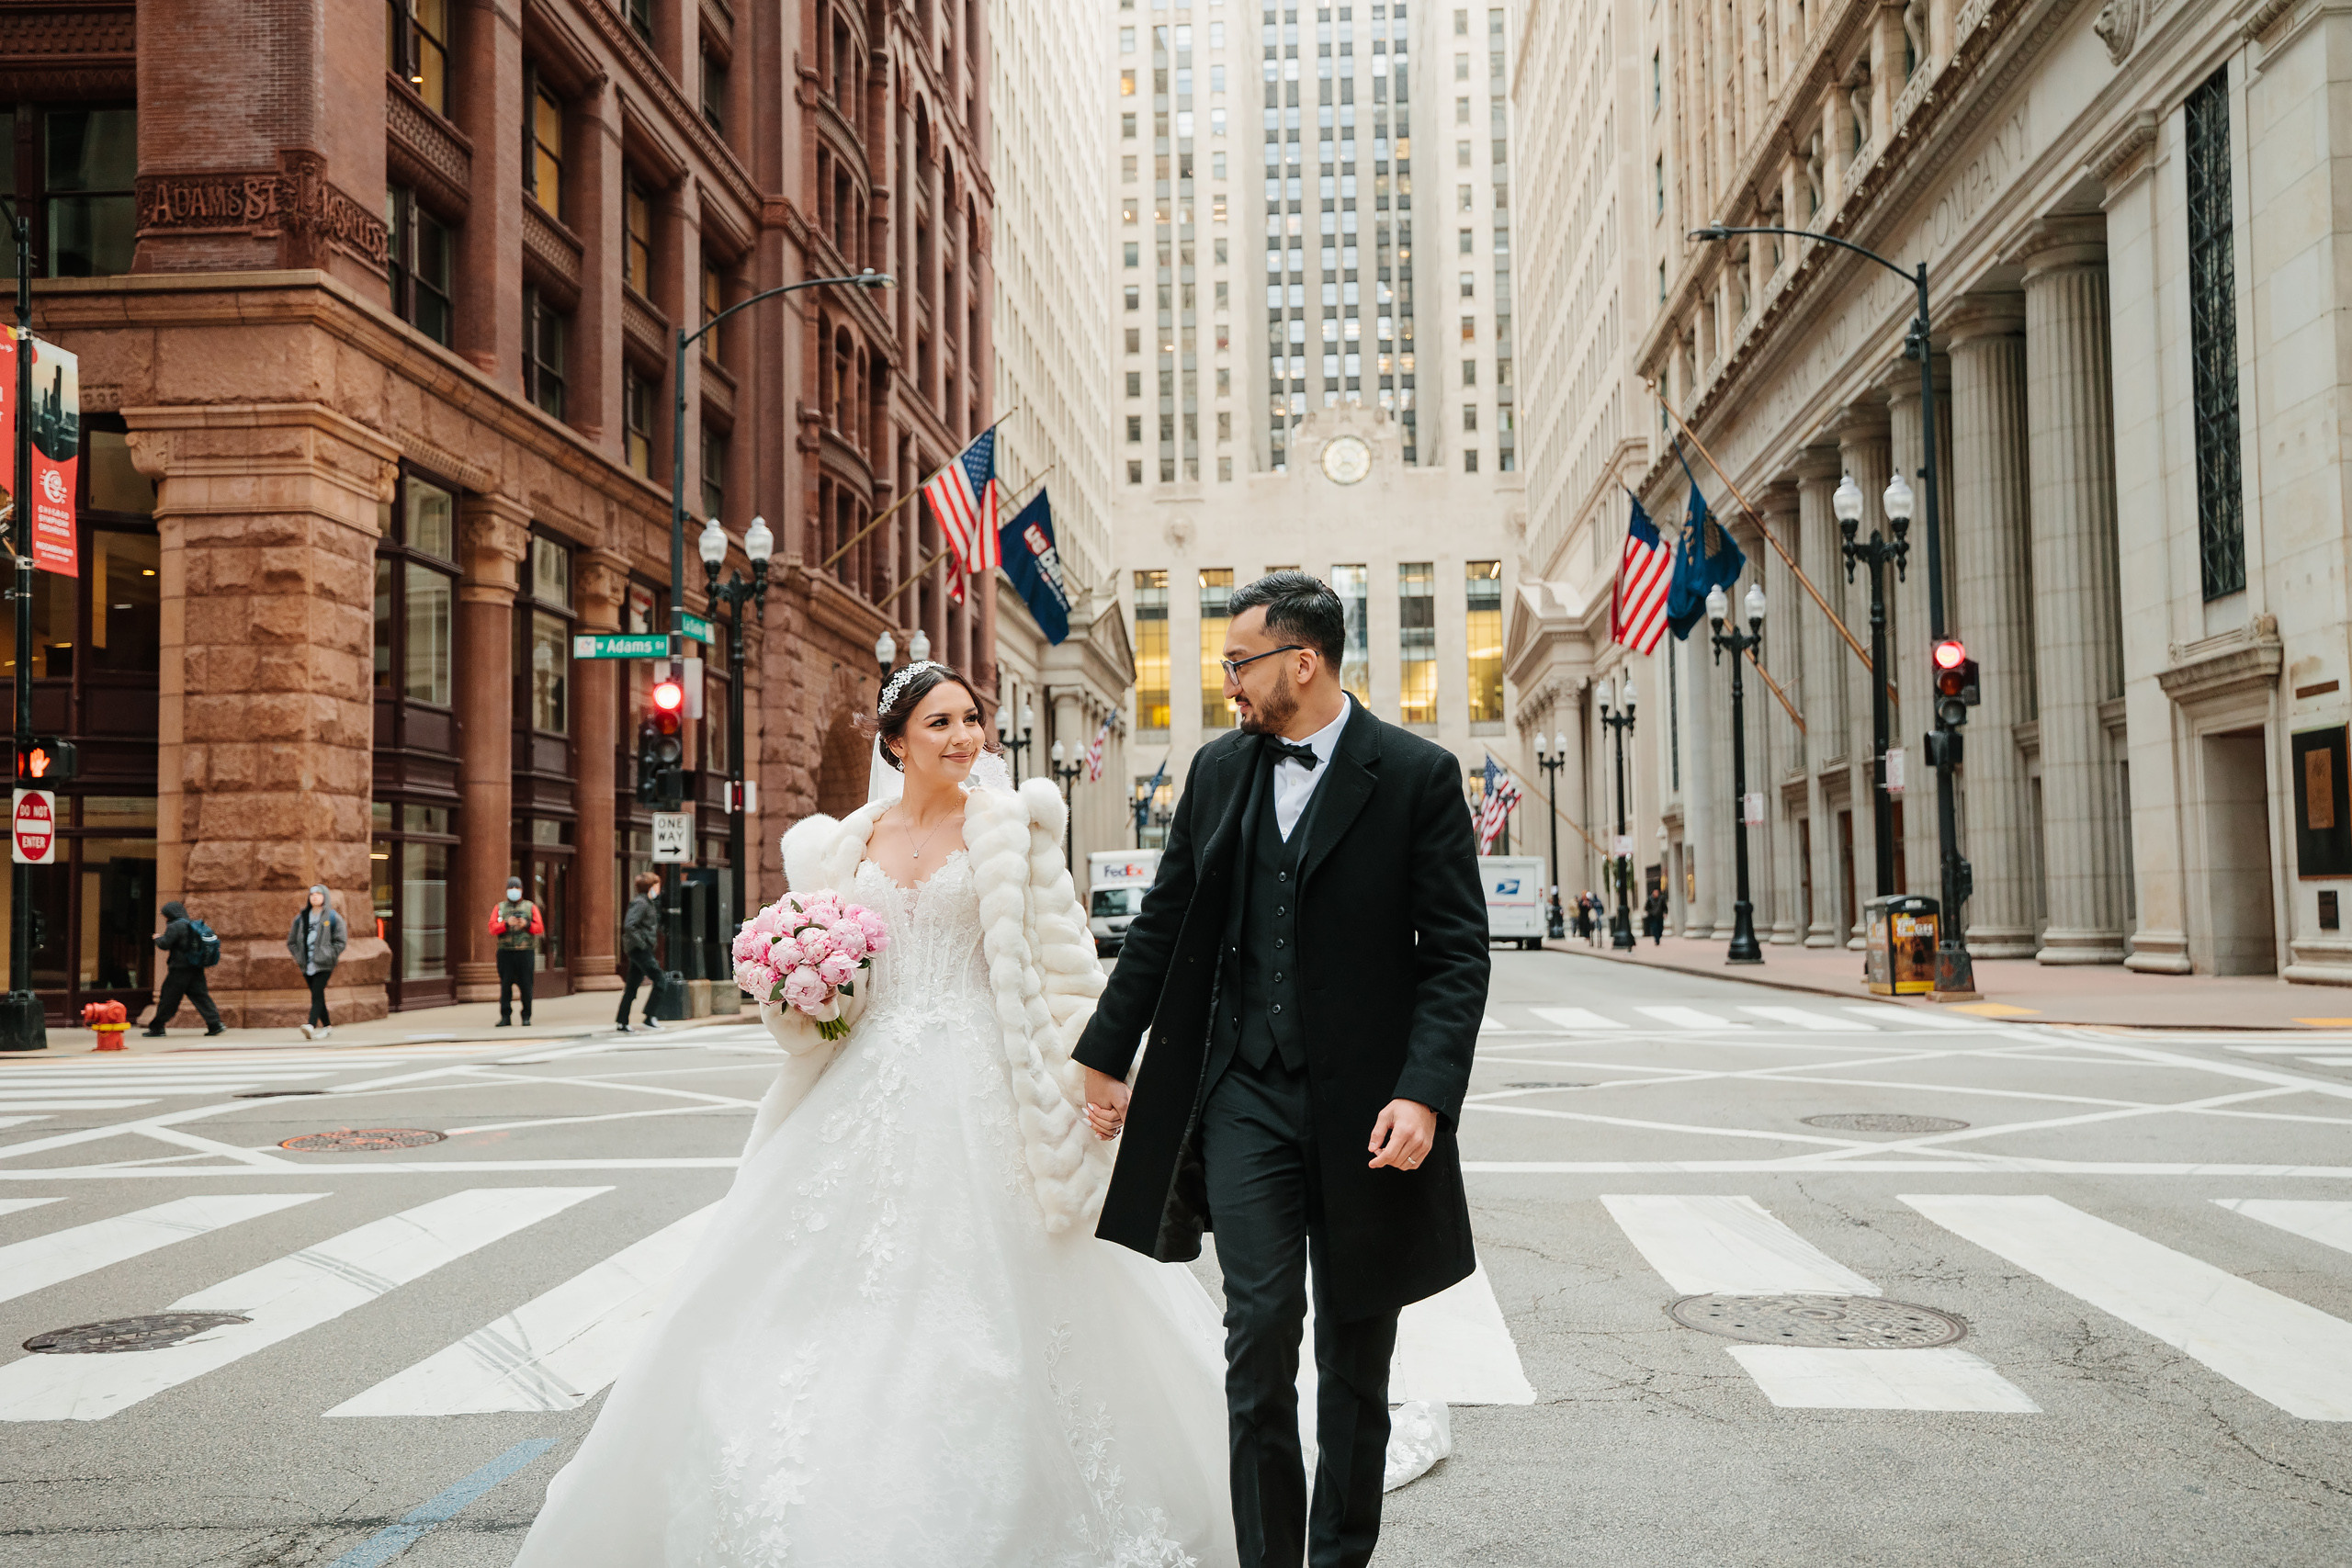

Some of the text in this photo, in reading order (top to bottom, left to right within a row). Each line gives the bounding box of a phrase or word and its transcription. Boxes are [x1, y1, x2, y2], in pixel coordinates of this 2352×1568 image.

[1918, 96, 2030, 265] COMPANY
[152, 177, 277, 223] ADAMS ST
[606, 638, 653, 653] Adams
[19, 804, 48, 818] DO NOT
[658, 818, 683, 829] ONE
[22, 835, 46, 850] ENTER
[658, 830, 684, 841] WAY
[1104, 863, 1144, 878] FedEx
